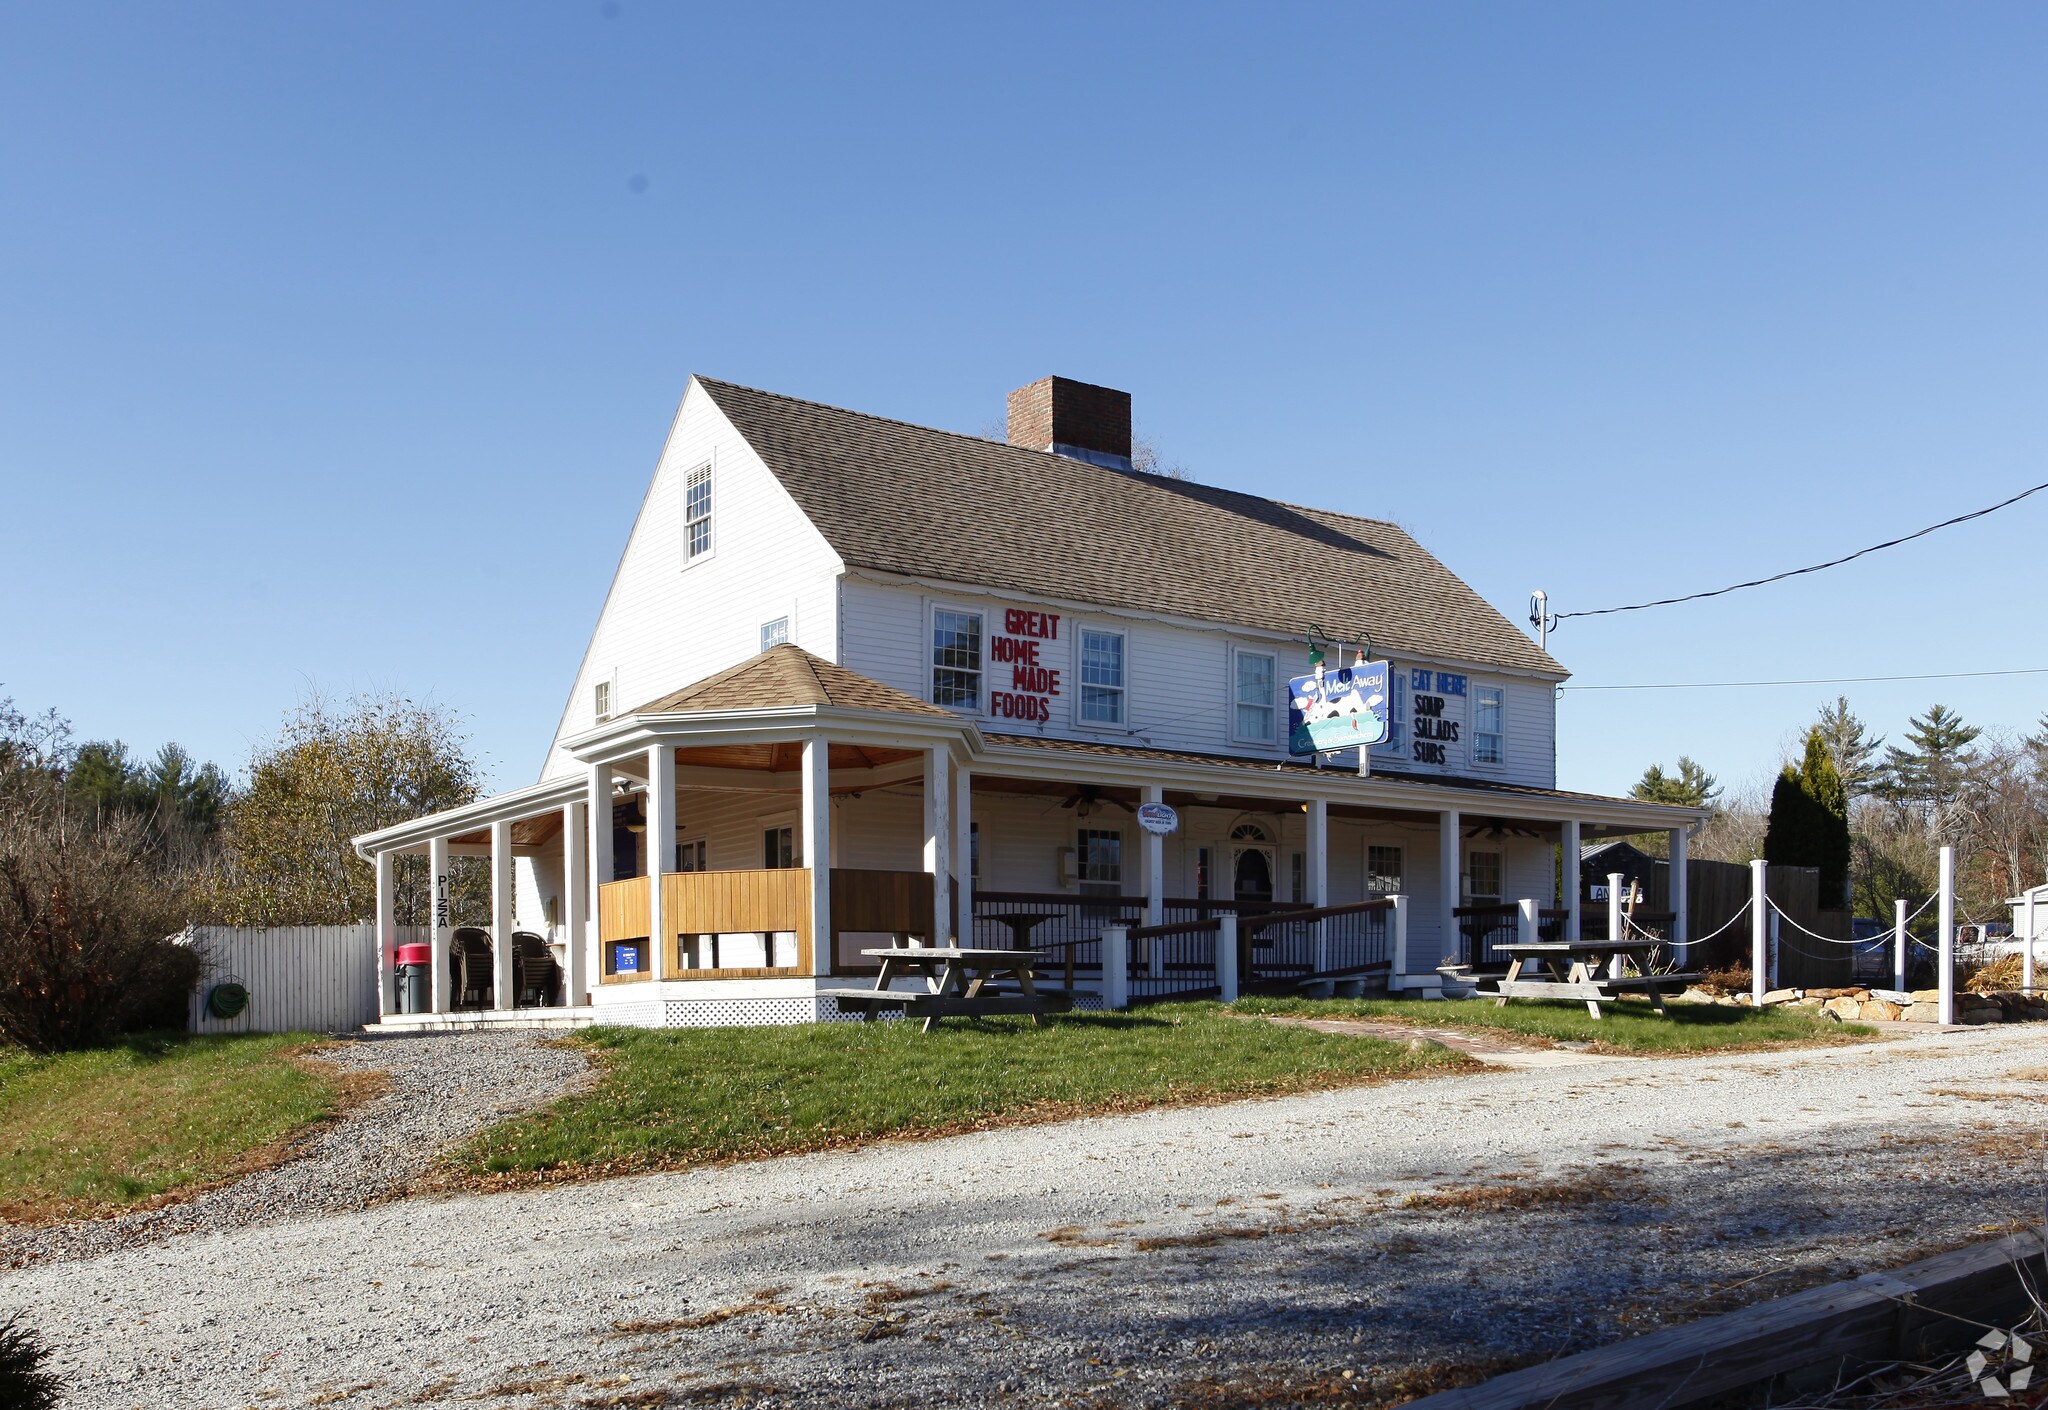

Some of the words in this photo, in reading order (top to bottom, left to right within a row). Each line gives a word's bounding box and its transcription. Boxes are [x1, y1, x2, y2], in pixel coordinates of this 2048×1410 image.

[1006, 608, 1060, 640] GREAT
[992, 635, 1039, 666] HOME
[1013, 665, 1060, 696] MADE
[1351, 672, 1384, 692] Away
[1412, 668, 1433, 691] EAT
[1437, 672, 1468, 697] HERE
[992, 691, 1050, 722] FOODS
[1414, 694, 1445, 718] SOUP
[1413, 717, 1460, 742] SALADS
[1413, 741, 1446, 765] SUBS
[438, 875, 448, 928] PIZZA
